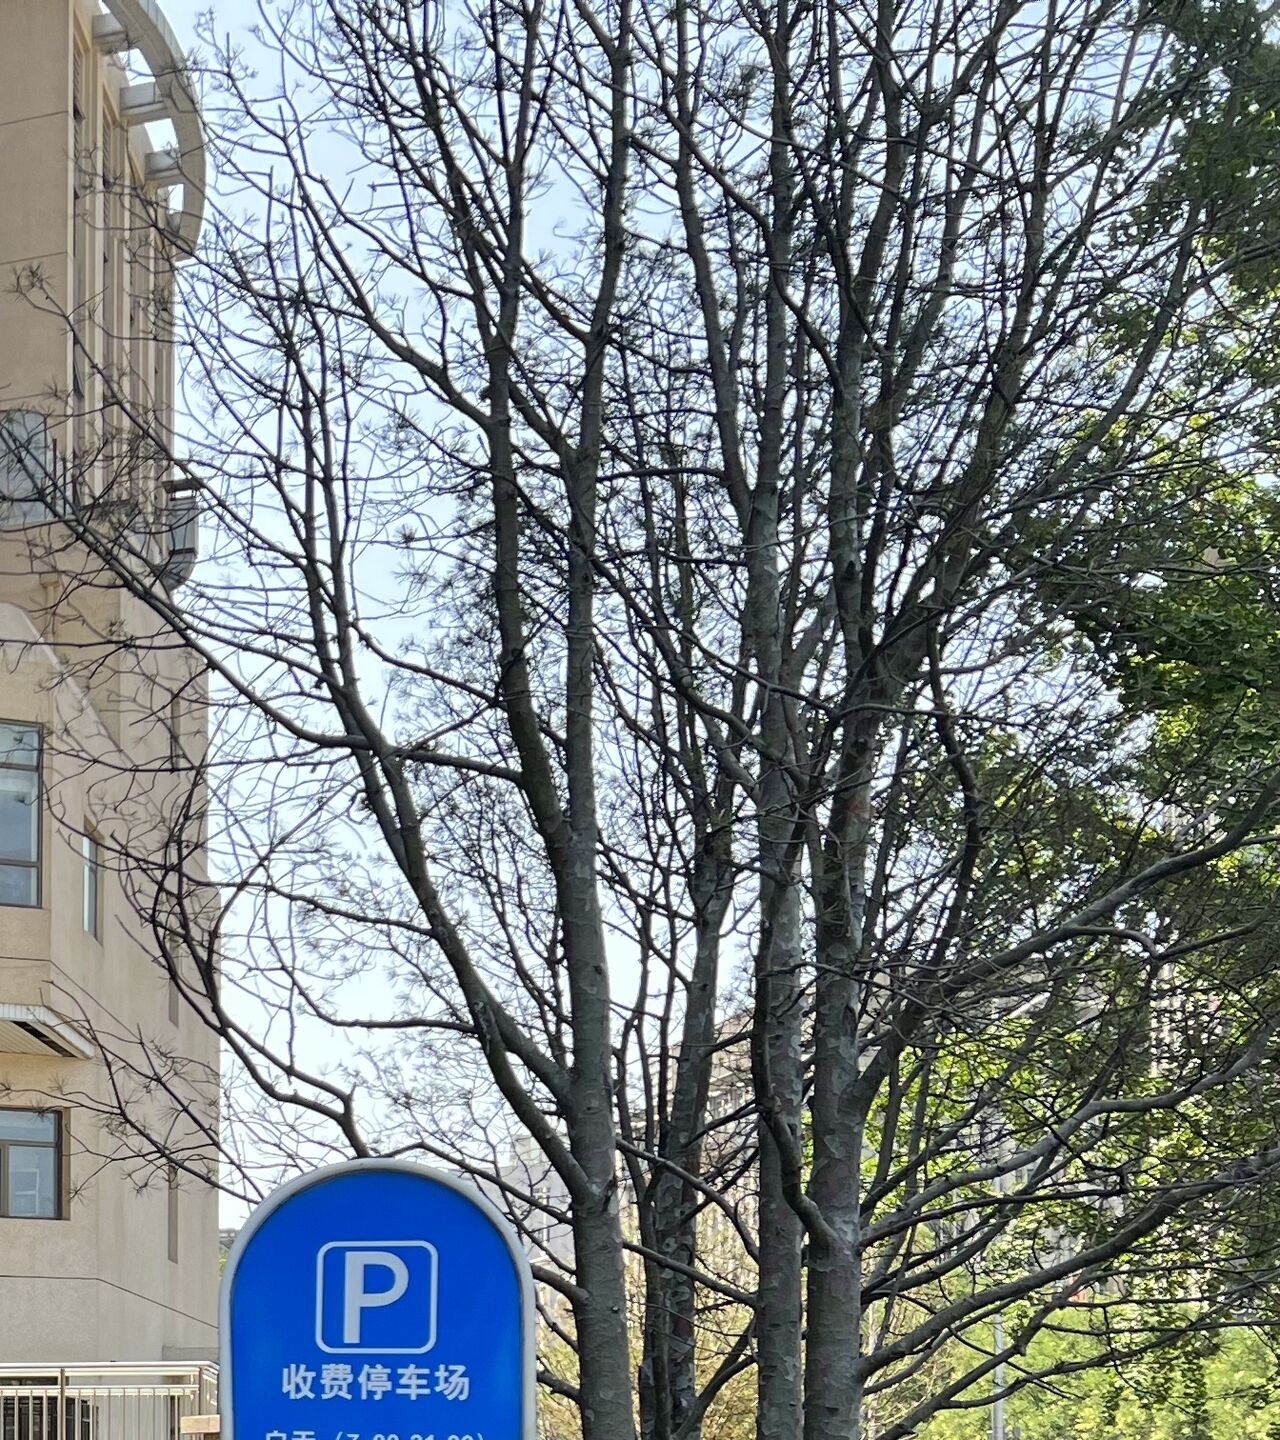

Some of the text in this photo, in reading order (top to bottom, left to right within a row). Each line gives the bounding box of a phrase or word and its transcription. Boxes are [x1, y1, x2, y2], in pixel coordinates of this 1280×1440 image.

[343, 1250, 410, 1344] P
[282, 1363, 471, 1402] 收费停车场
